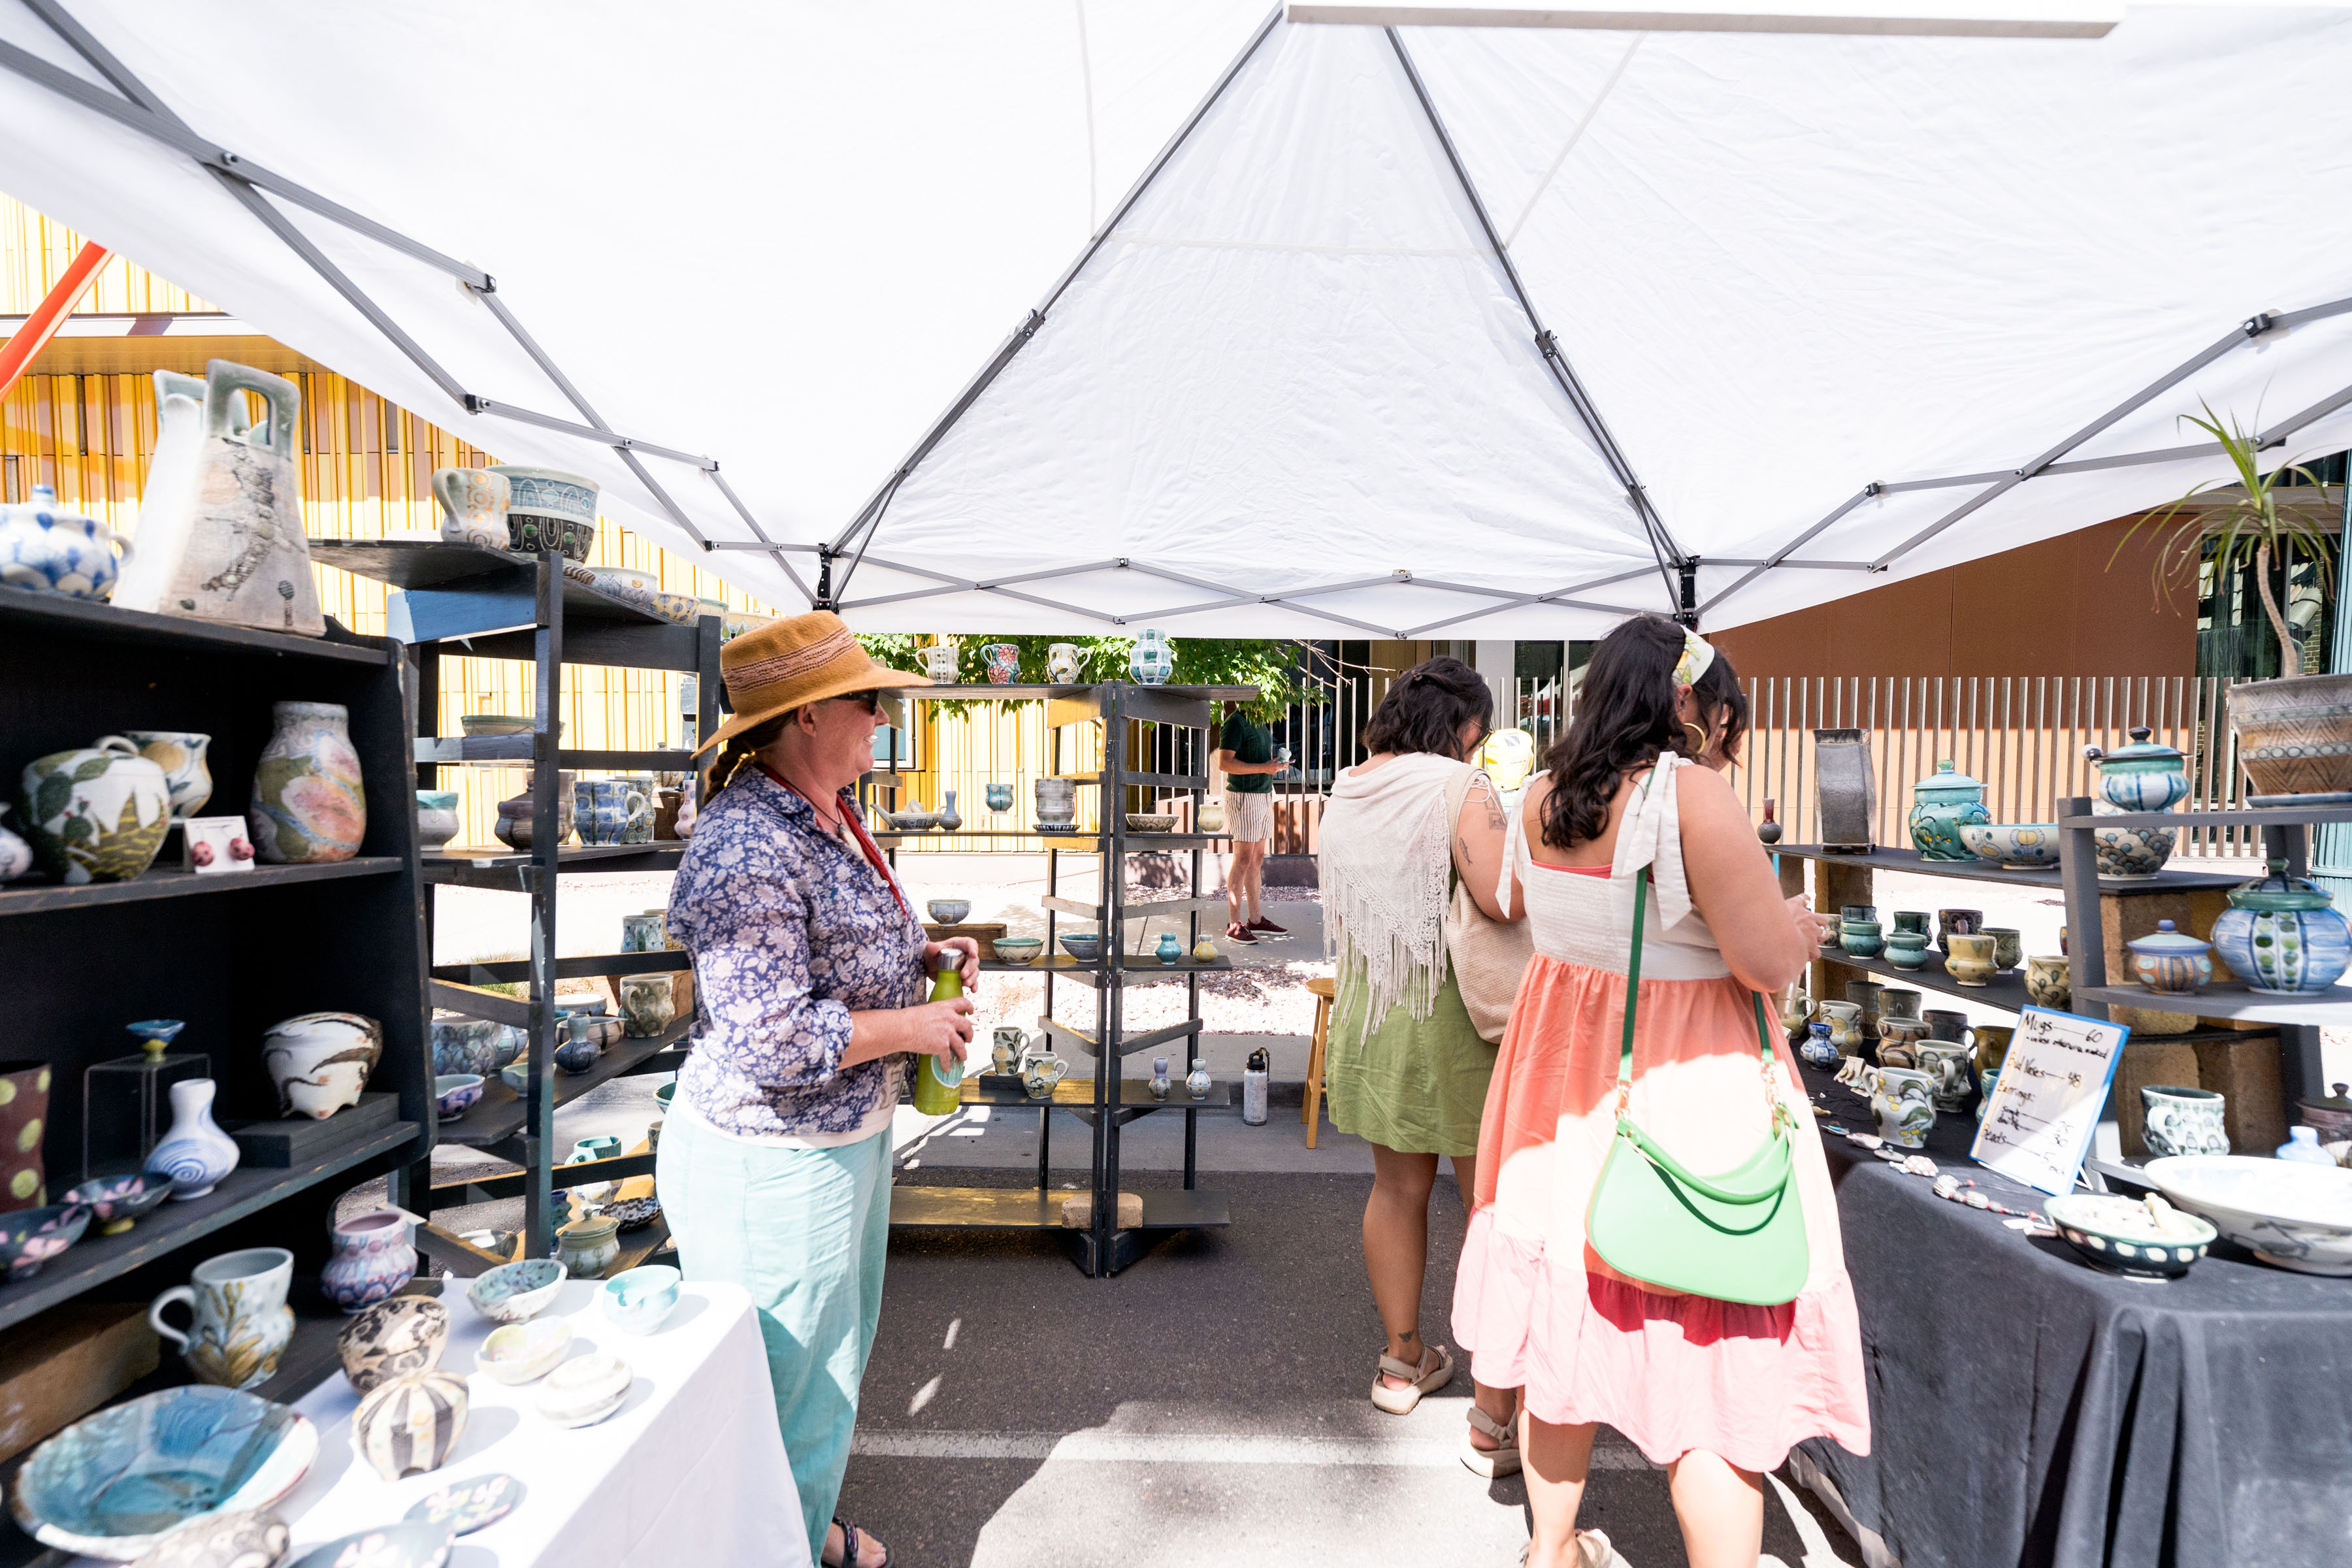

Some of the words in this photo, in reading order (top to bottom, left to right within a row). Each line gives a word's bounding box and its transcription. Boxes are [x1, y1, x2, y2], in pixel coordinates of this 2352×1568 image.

[2024, 1013, 2053, 1035] Mugs
[2085, 1029, 2104, 1043] 60
[2068, 1071, 2082, 1088] 48
[1982, 1123, 2007, 1145] Beads
